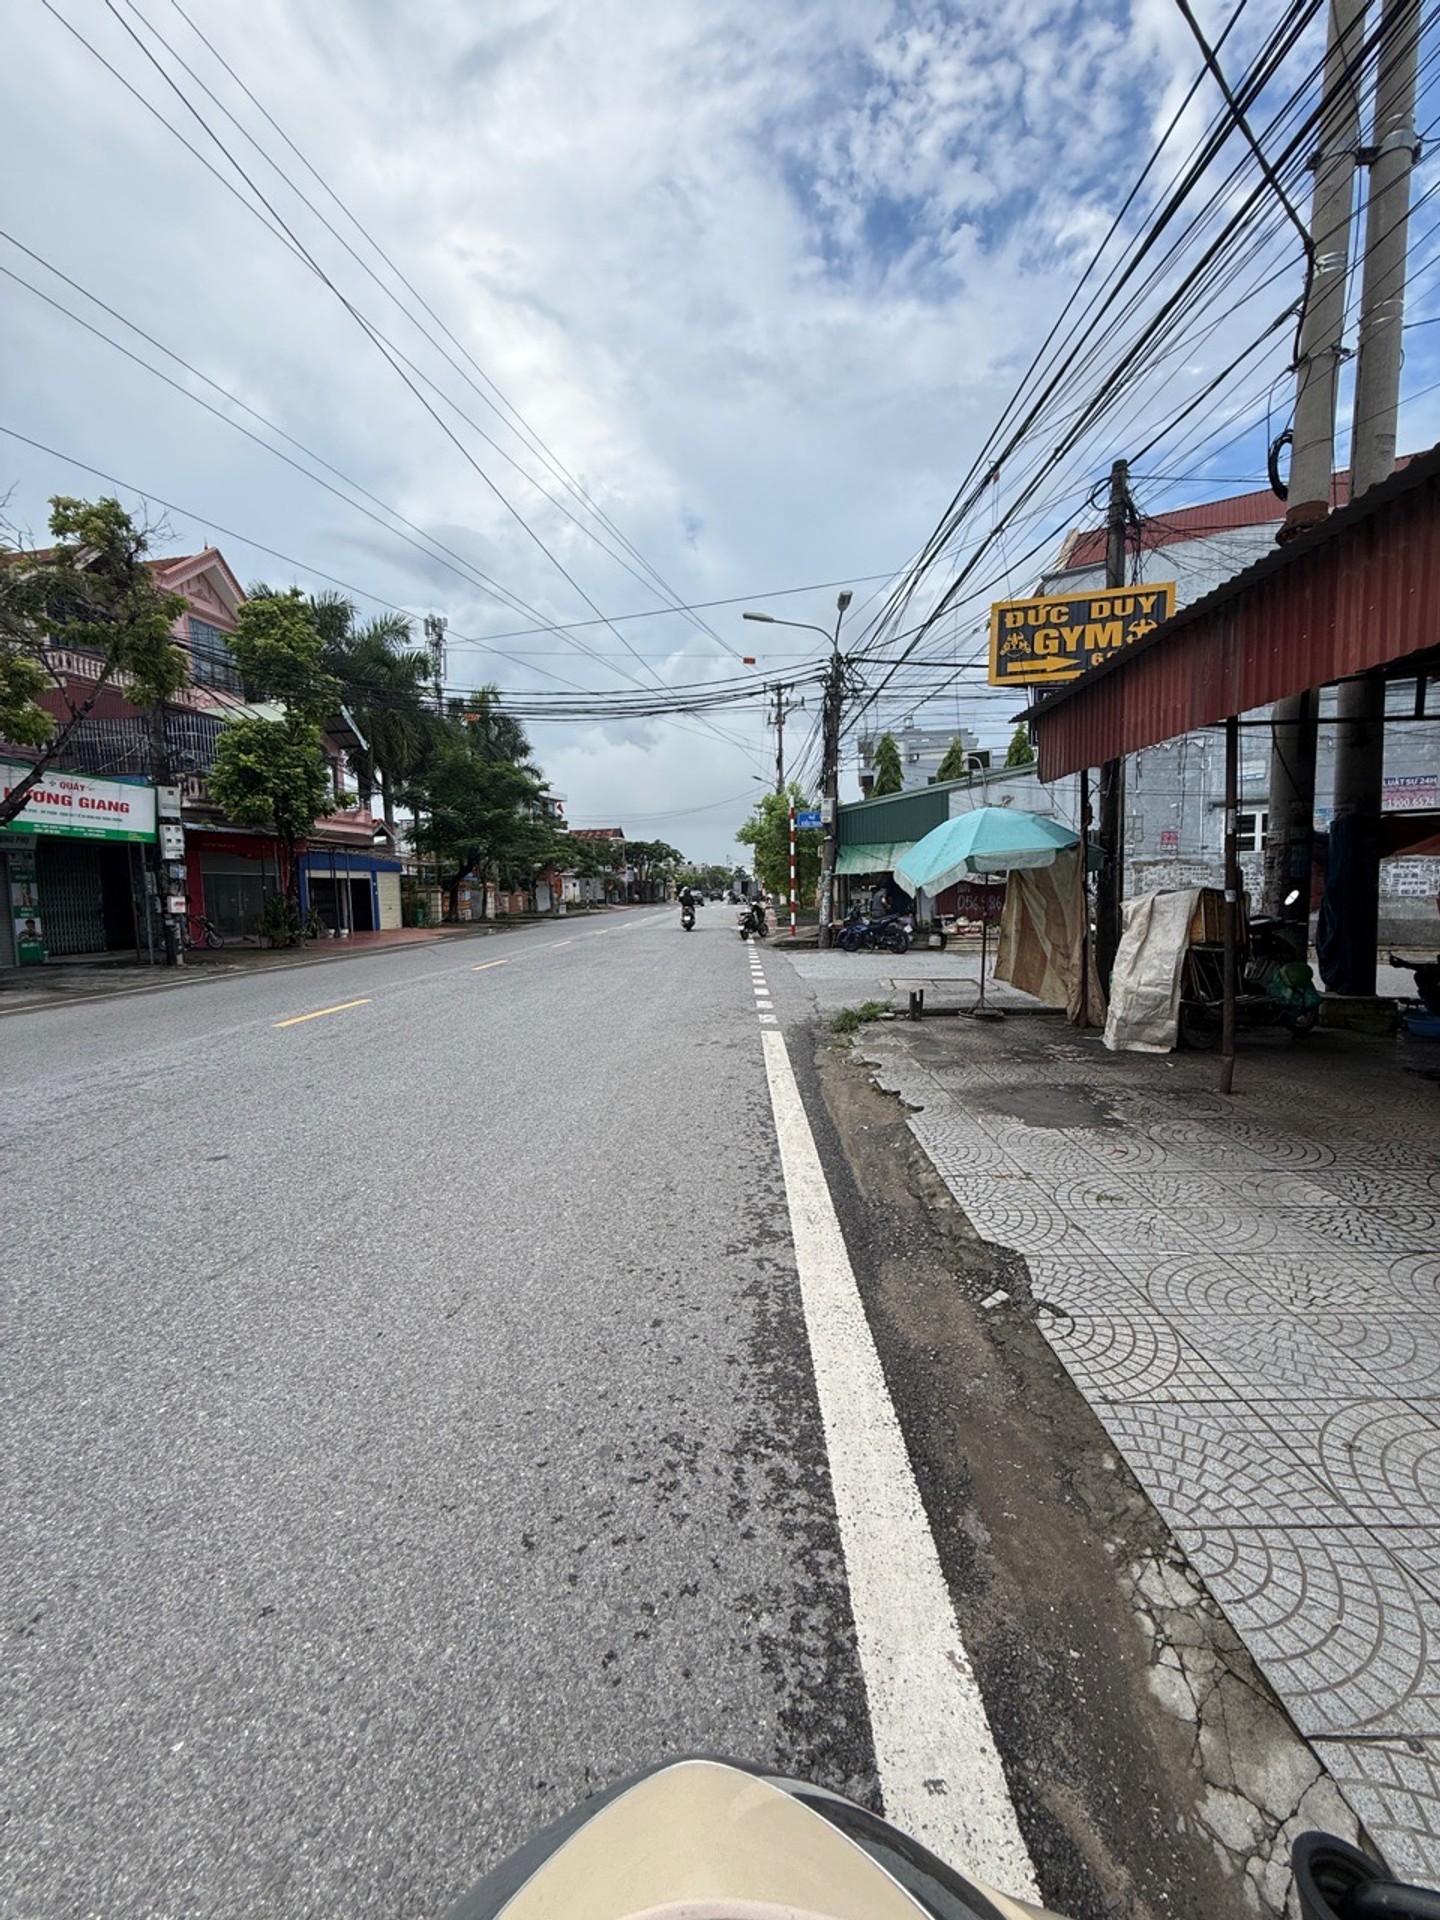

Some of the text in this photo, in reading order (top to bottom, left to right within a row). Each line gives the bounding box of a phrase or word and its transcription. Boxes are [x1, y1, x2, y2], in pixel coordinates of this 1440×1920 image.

[1005, 594, 1158, 628] ĐỨC DUY
[1033, 621, 1123, 655] GYM
[78, 797, 130, 814] GIANG
